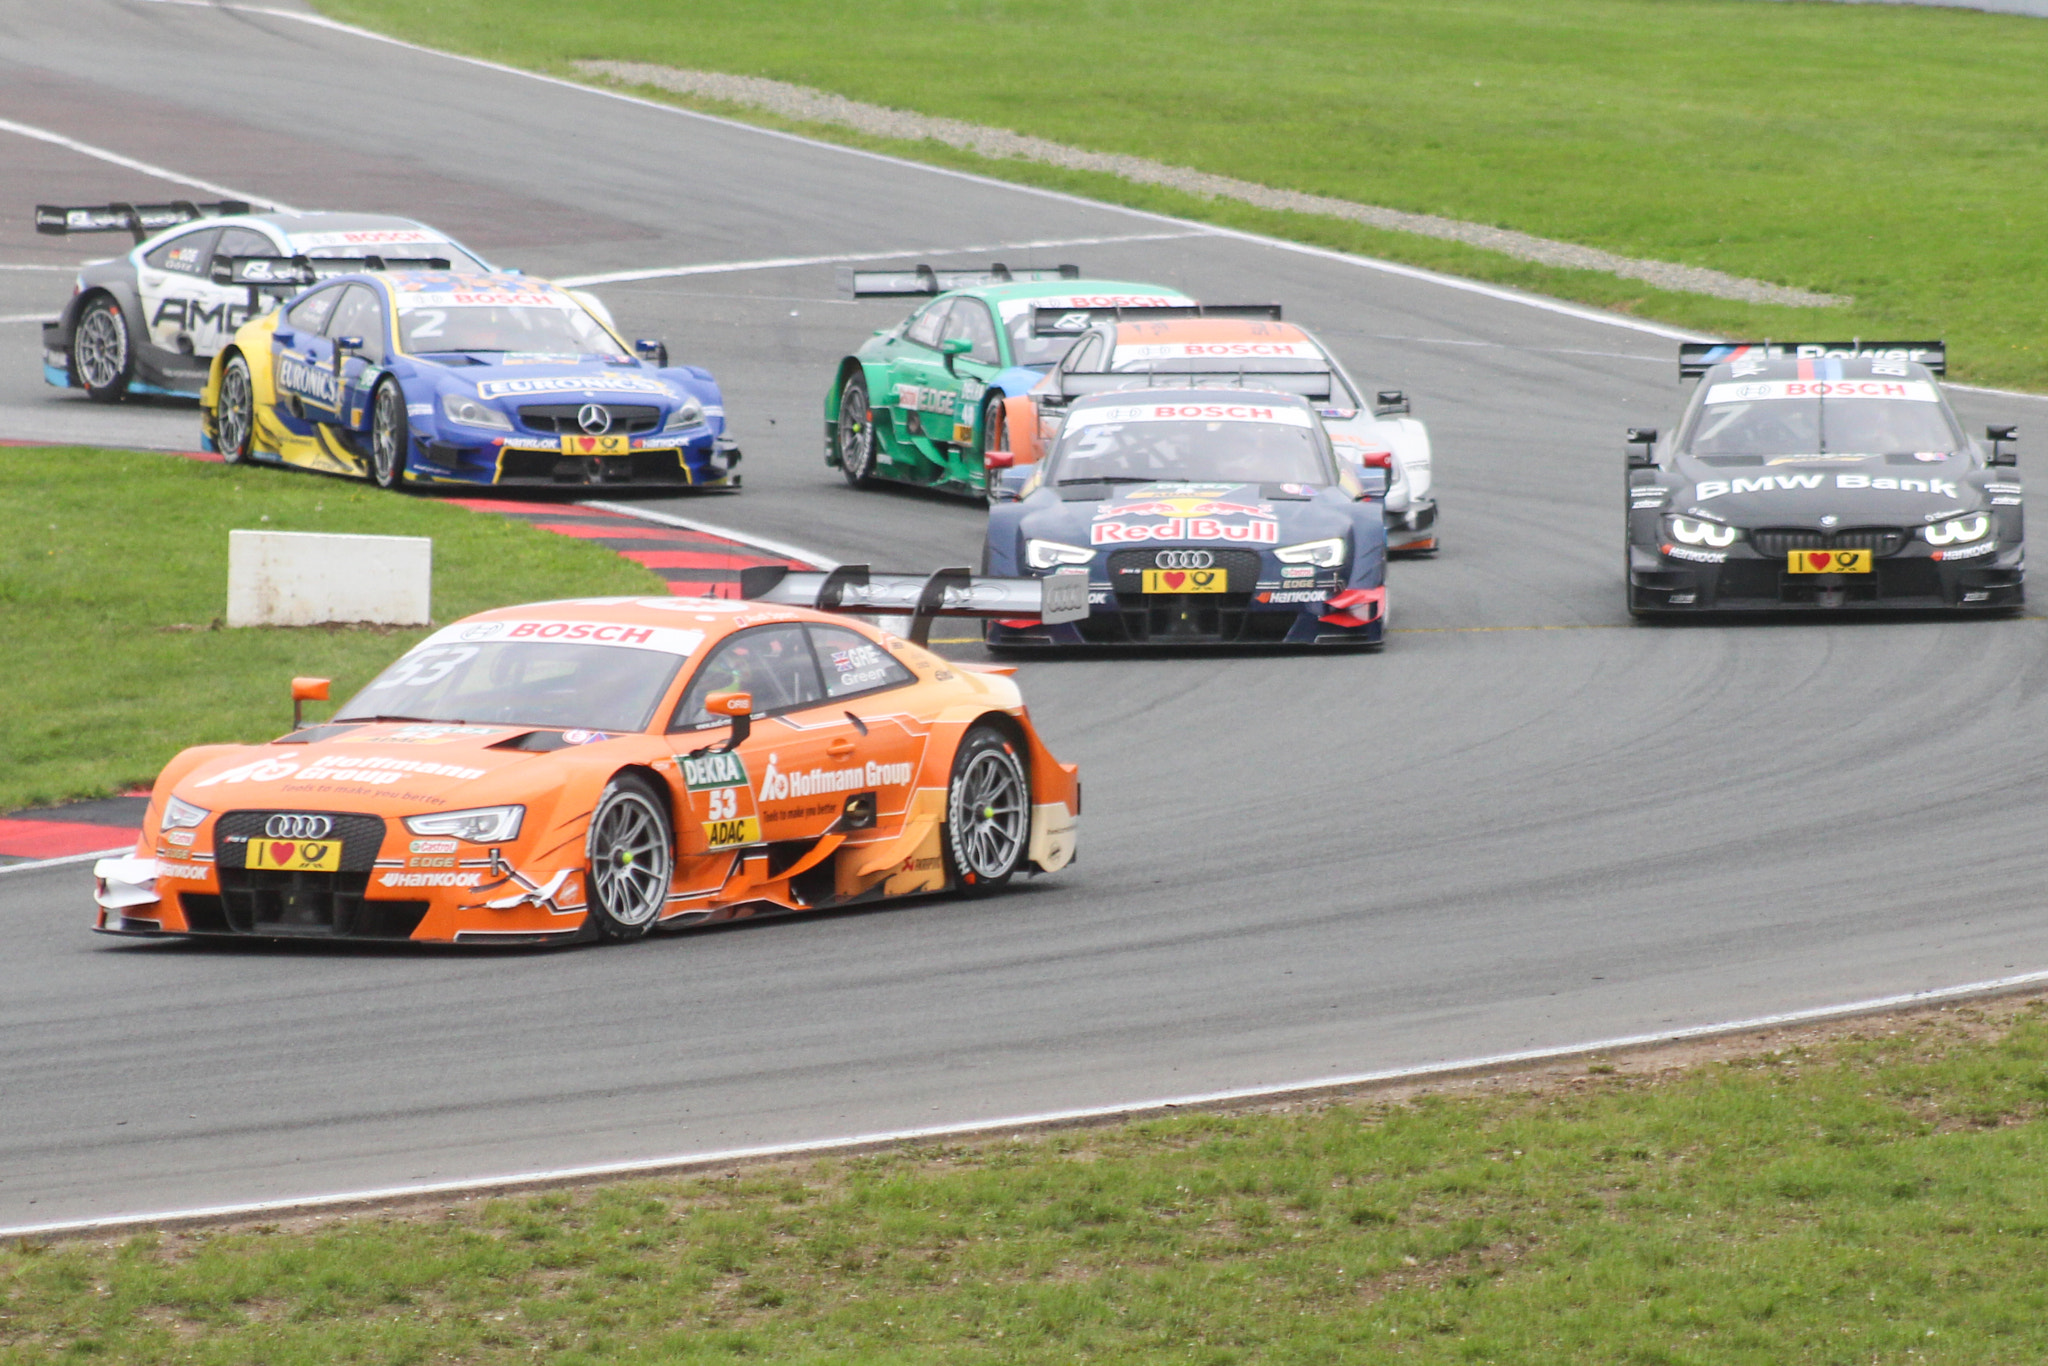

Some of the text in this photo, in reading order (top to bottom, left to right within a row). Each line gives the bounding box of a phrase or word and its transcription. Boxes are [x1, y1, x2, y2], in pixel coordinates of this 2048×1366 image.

[344, 231, 426, 243] BOSCH
[454, 293, 553, 305] BOSCH
[1070, 296, 1171, 308] BOSCH
[410, 309, 448, 338] 2
[1184, 344, 1295, 355] BOSCH
[281, 360, 337, 402] EURONICS
[490, 377, 658, 394] EURONICS
[1785, 383, 1906, 396] BOSCH
[920, 387, 957, 416] EDGE
[1154, 406, 1273, 420] BOSCH
[1698, 404, 1752, 441] 7
[1696, 474, 1824, 501] BMW
[1836, 474, 1957, 499] Bank
[1091, 518, 1279, 545] Red Bull
[1283, 579, 1315, 589] EDGE
[508, 623, 654, 644] BOSCH
[848, 645, 881, 668] GRE
[371, 646, 481, 690] 53
[840, 668, 886, 686] Green
[294, 766, 404, 785] Group
[311, 755, 487, 780] Hoffmann
[683, 755, 740, 785] DEKRA
[789, 760, 912, 798] Hoffmann Group
[282, 784, 447, 806] Tools to make you better
[708, 788, 738, 820] 53
[817, 803, 837, 815] better
[709, 820, 745, 846] ADAC
[419, 841, 456, 852] Castrol
[409, 857, 457, 867] EDGE
